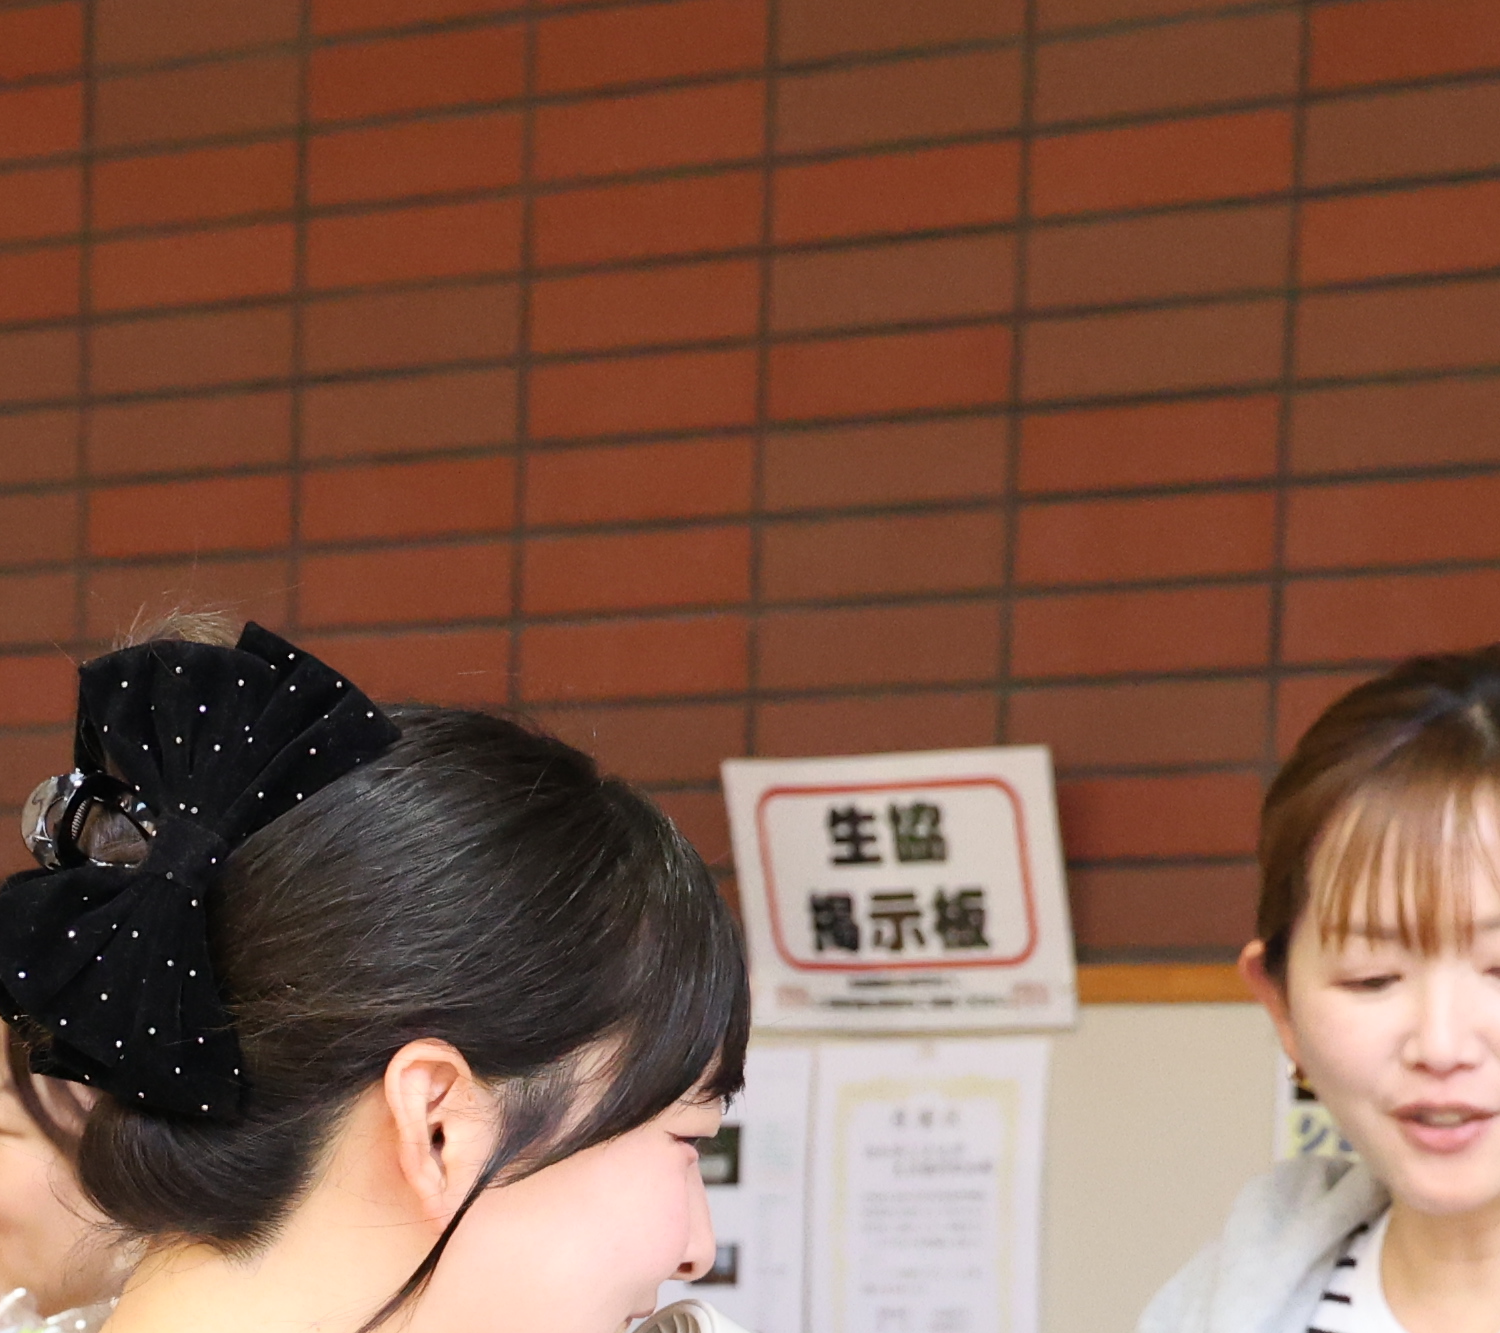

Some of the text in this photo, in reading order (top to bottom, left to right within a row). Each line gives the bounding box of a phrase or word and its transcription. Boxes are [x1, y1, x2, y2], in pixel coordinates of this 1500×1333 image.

[828, 802, 946, 864] 生協
[811, 887, 989, 952] 掲示板
